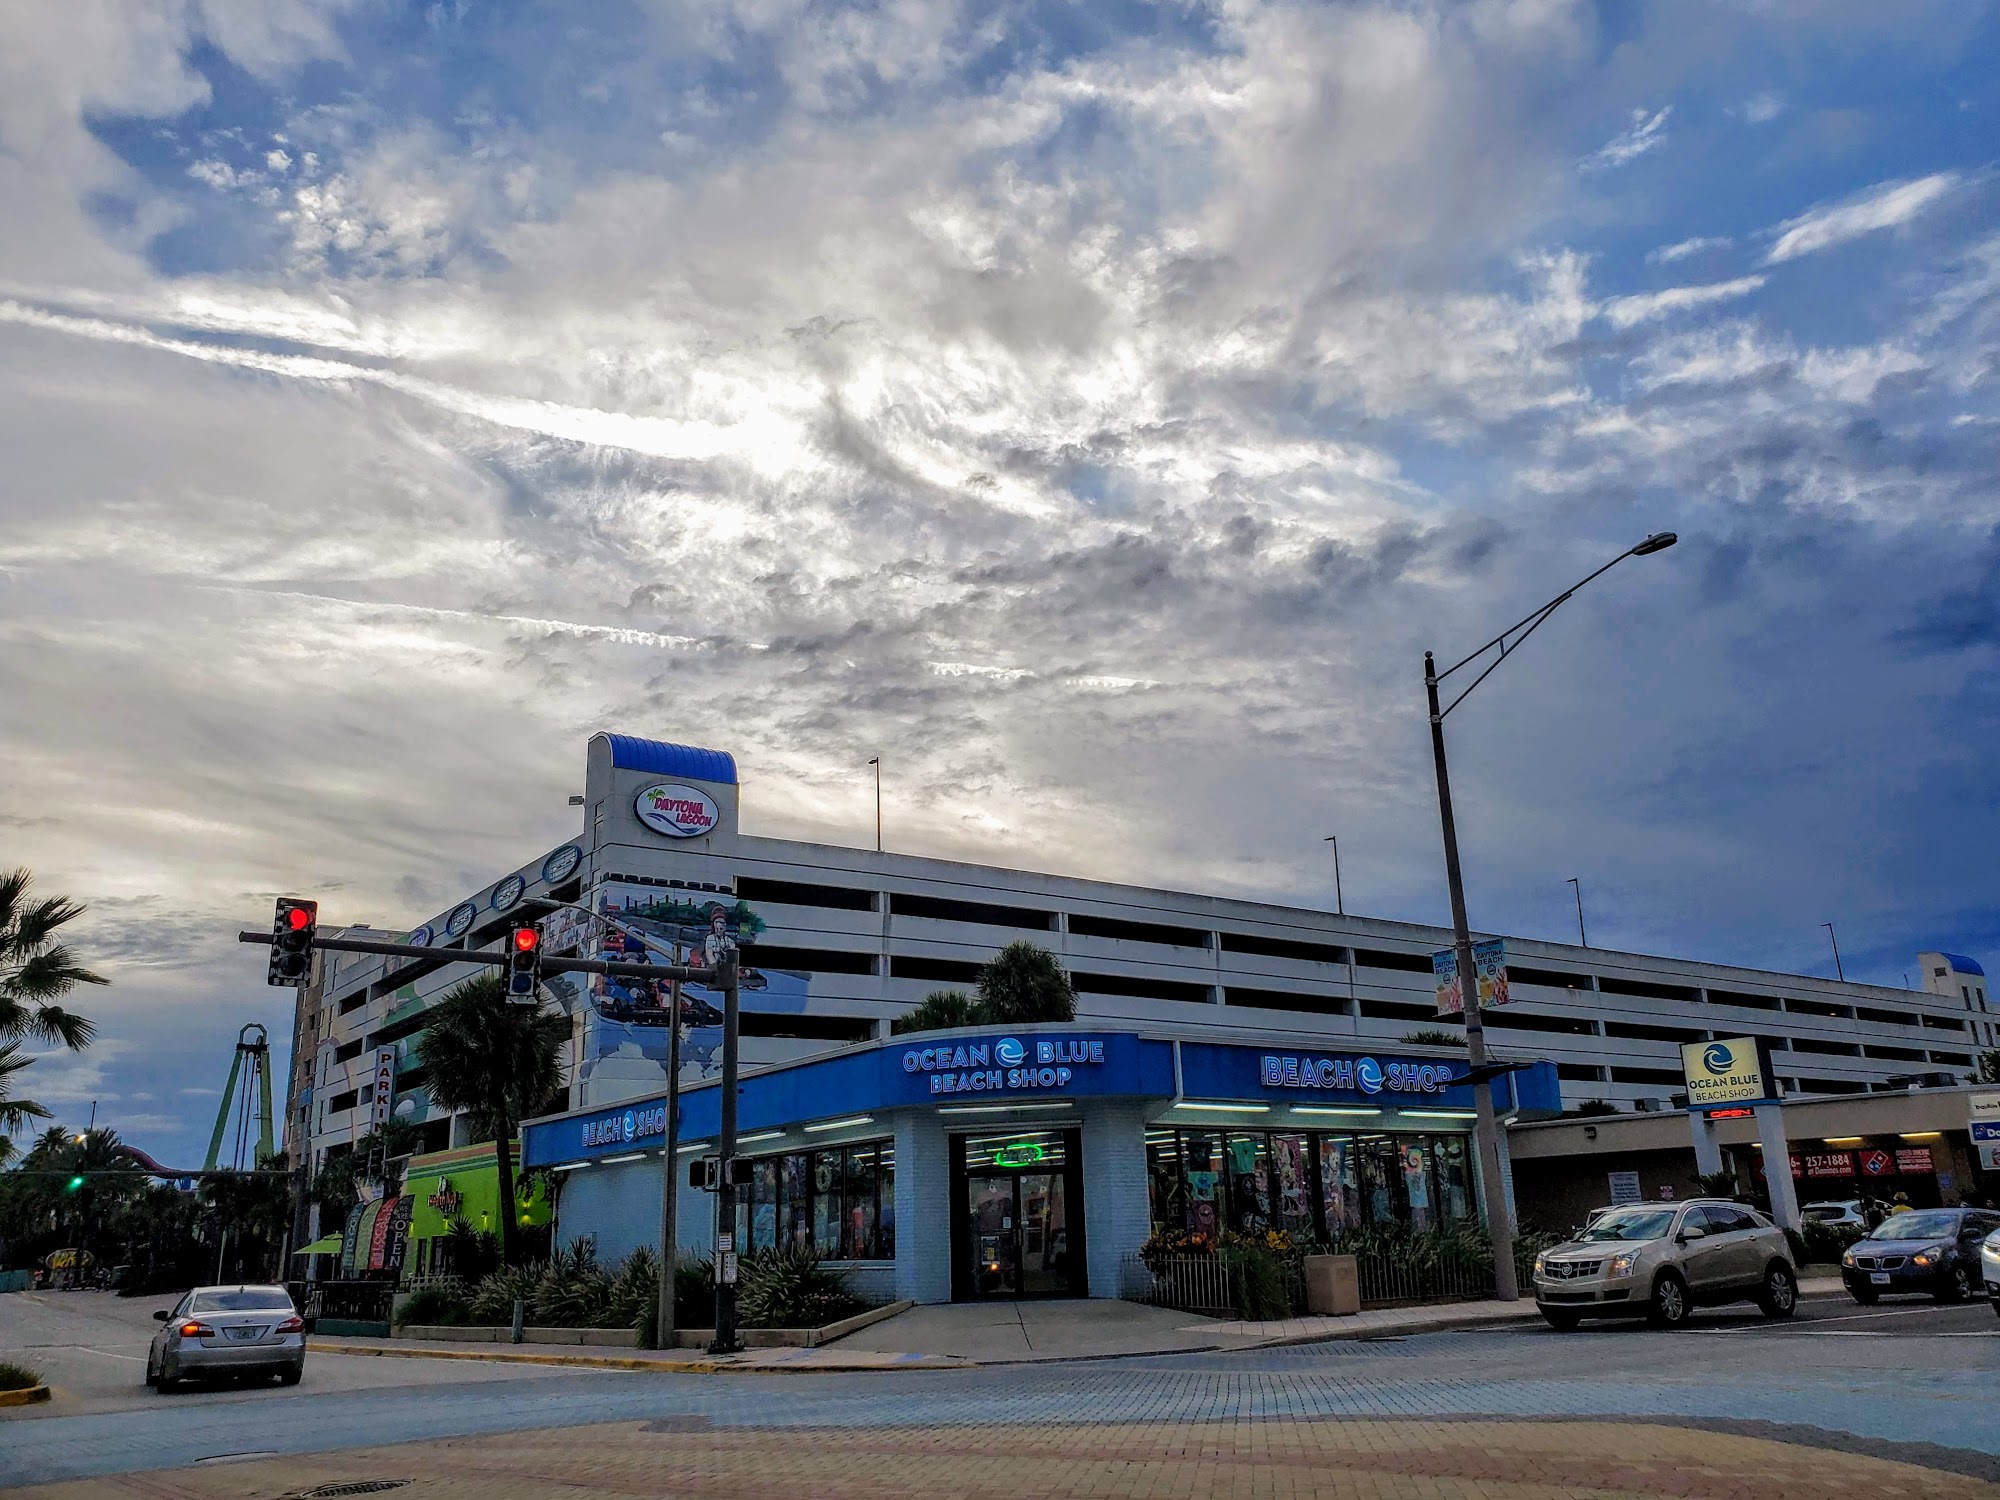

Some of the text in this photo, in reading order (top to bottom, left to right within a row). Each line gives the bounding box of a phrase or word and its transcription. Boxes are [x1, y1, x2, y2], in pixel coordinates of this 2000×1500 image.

[654, 797, 704, 815] DAYTONA
[675, 812, 713, 827] LAGOON
[1476, 949, 1503, 959] DAYTONA
[1477, 955, 1504, 966] BEACH
[1435, 966, 1456, 975] BEACH
[903, 1040, 1105, 1072] OCEAN BLUE
[930, 1066, 1072, 1094] BEACH SHOP
[1263, 1055, 1453, 1093] BEACH SHOP
[1688, 1074, 1760, 1090] OCEAN BLUE
[1695, 1087, 1755, 1101] BEACH SHOP
[1710, 1108, 1751, 1118] OPEN
[582, 1107, 667, 1147] BEACH SHO
[1805, 1154, 1850, 1168] 257-1884
[396, 1212, 409, 1220] ARE
[389, 1219, 407, 1268] OPEN
